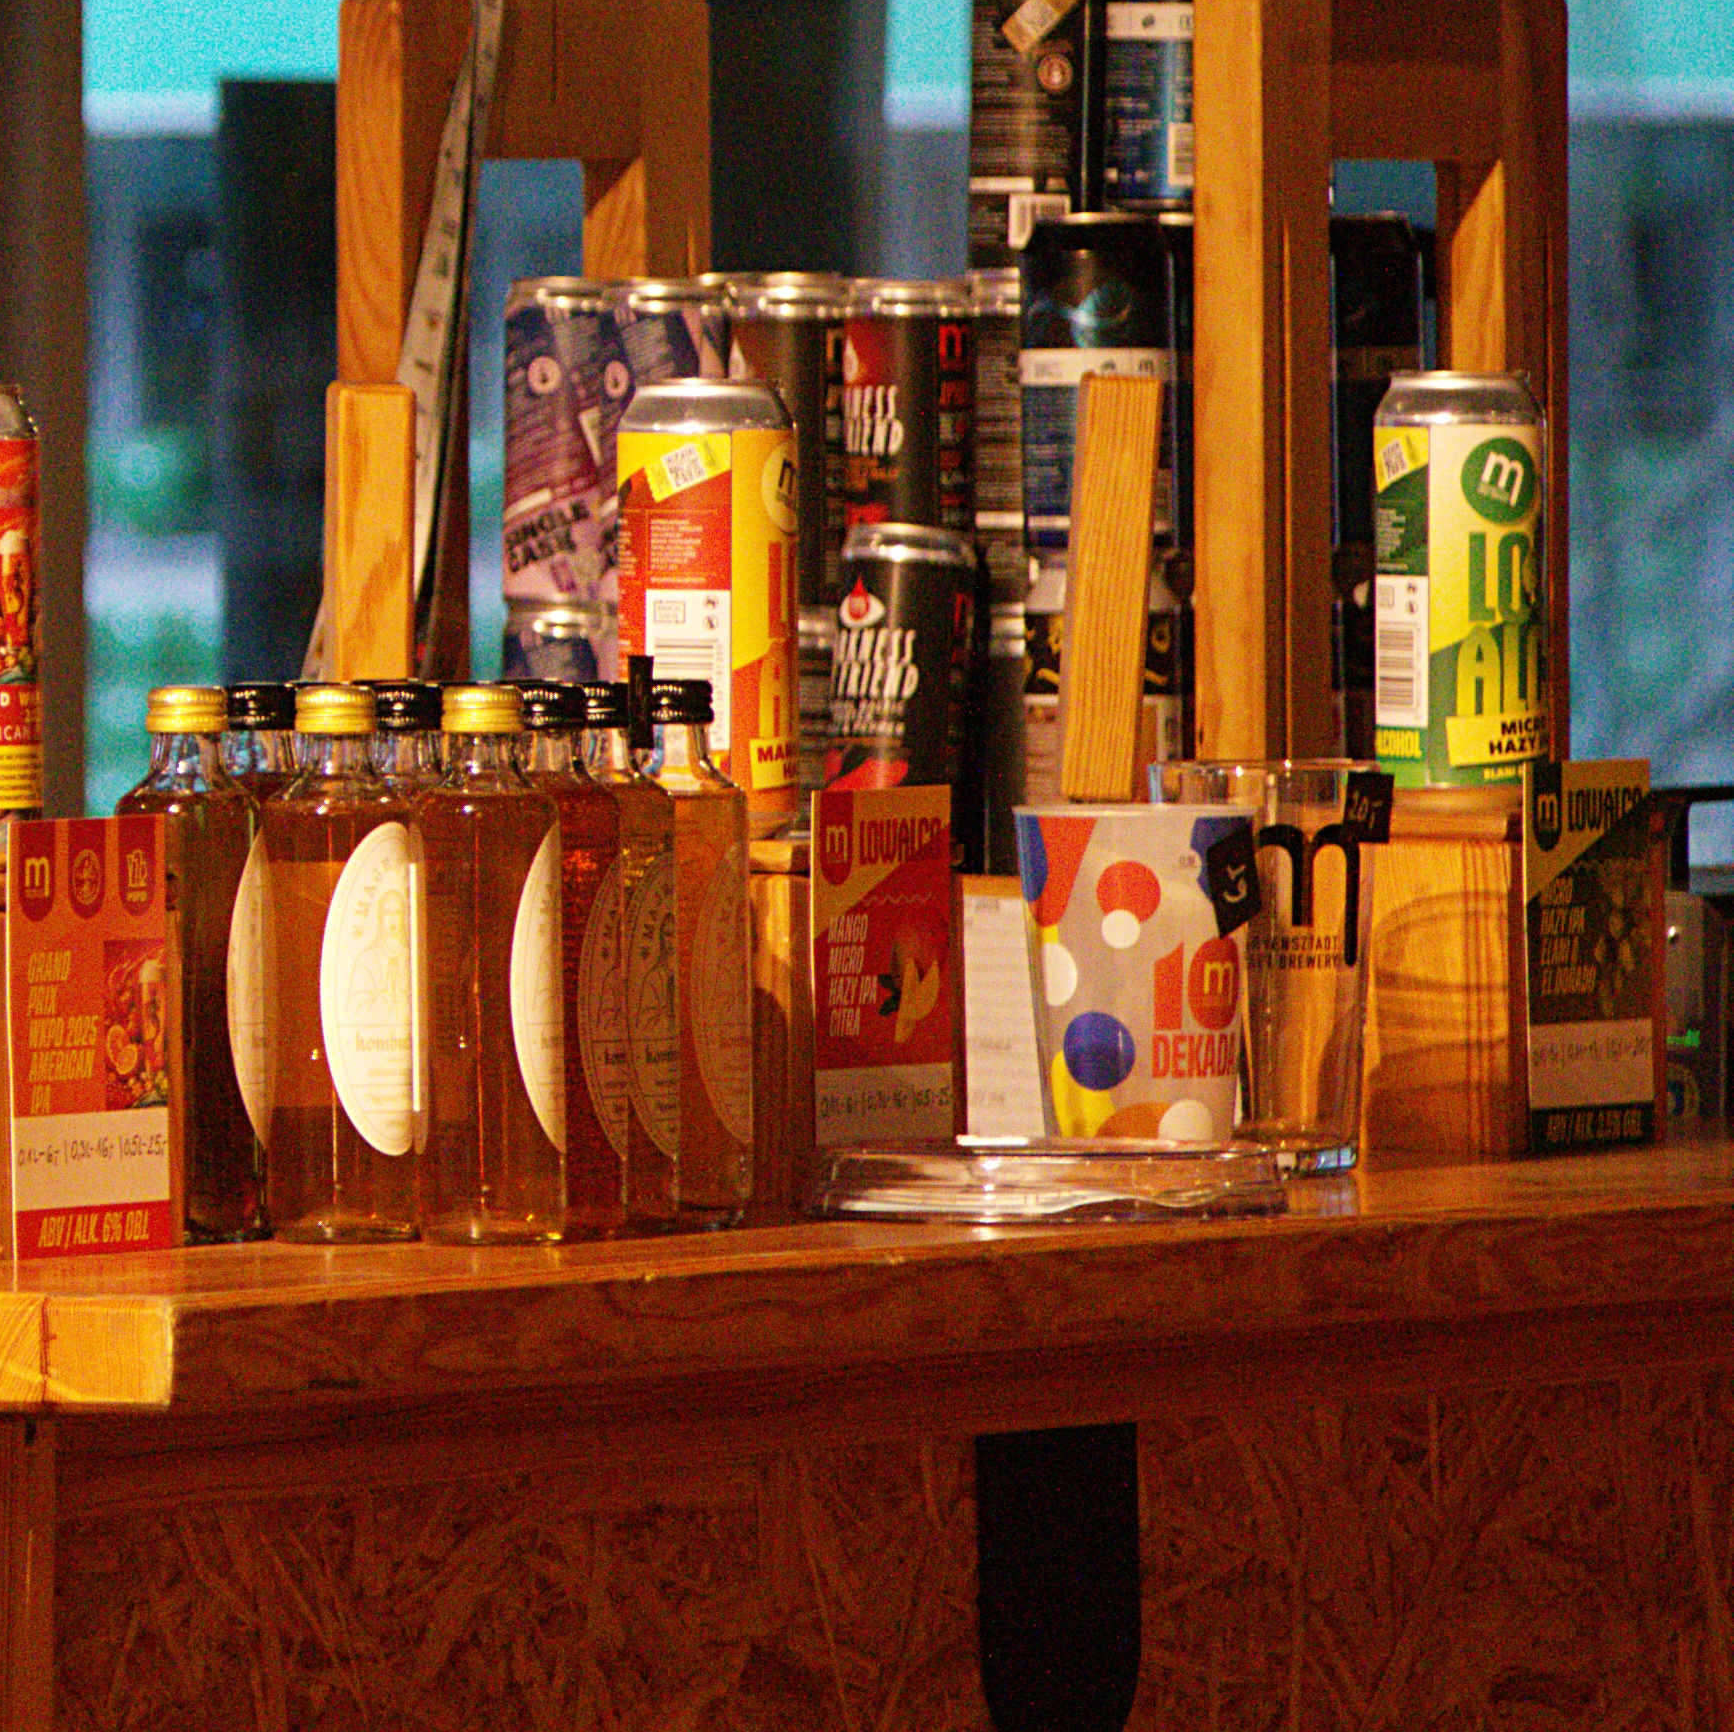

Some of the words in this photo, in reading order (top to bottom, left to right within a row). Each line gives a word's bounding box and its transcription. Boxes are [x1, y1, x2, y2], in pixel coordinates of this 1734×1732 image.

[1487, 731, 1536, 756] HAZY
[858, 817, 942, 866] LOWALCO
[827, 912, 870, 944] MANGO
[827, 943, 866, 976] MICRO
[827, 974, 858, 1007] HAZY
[858, 973, 878, 1005] IPA
[37, 1213, 66, 1250] ABV
